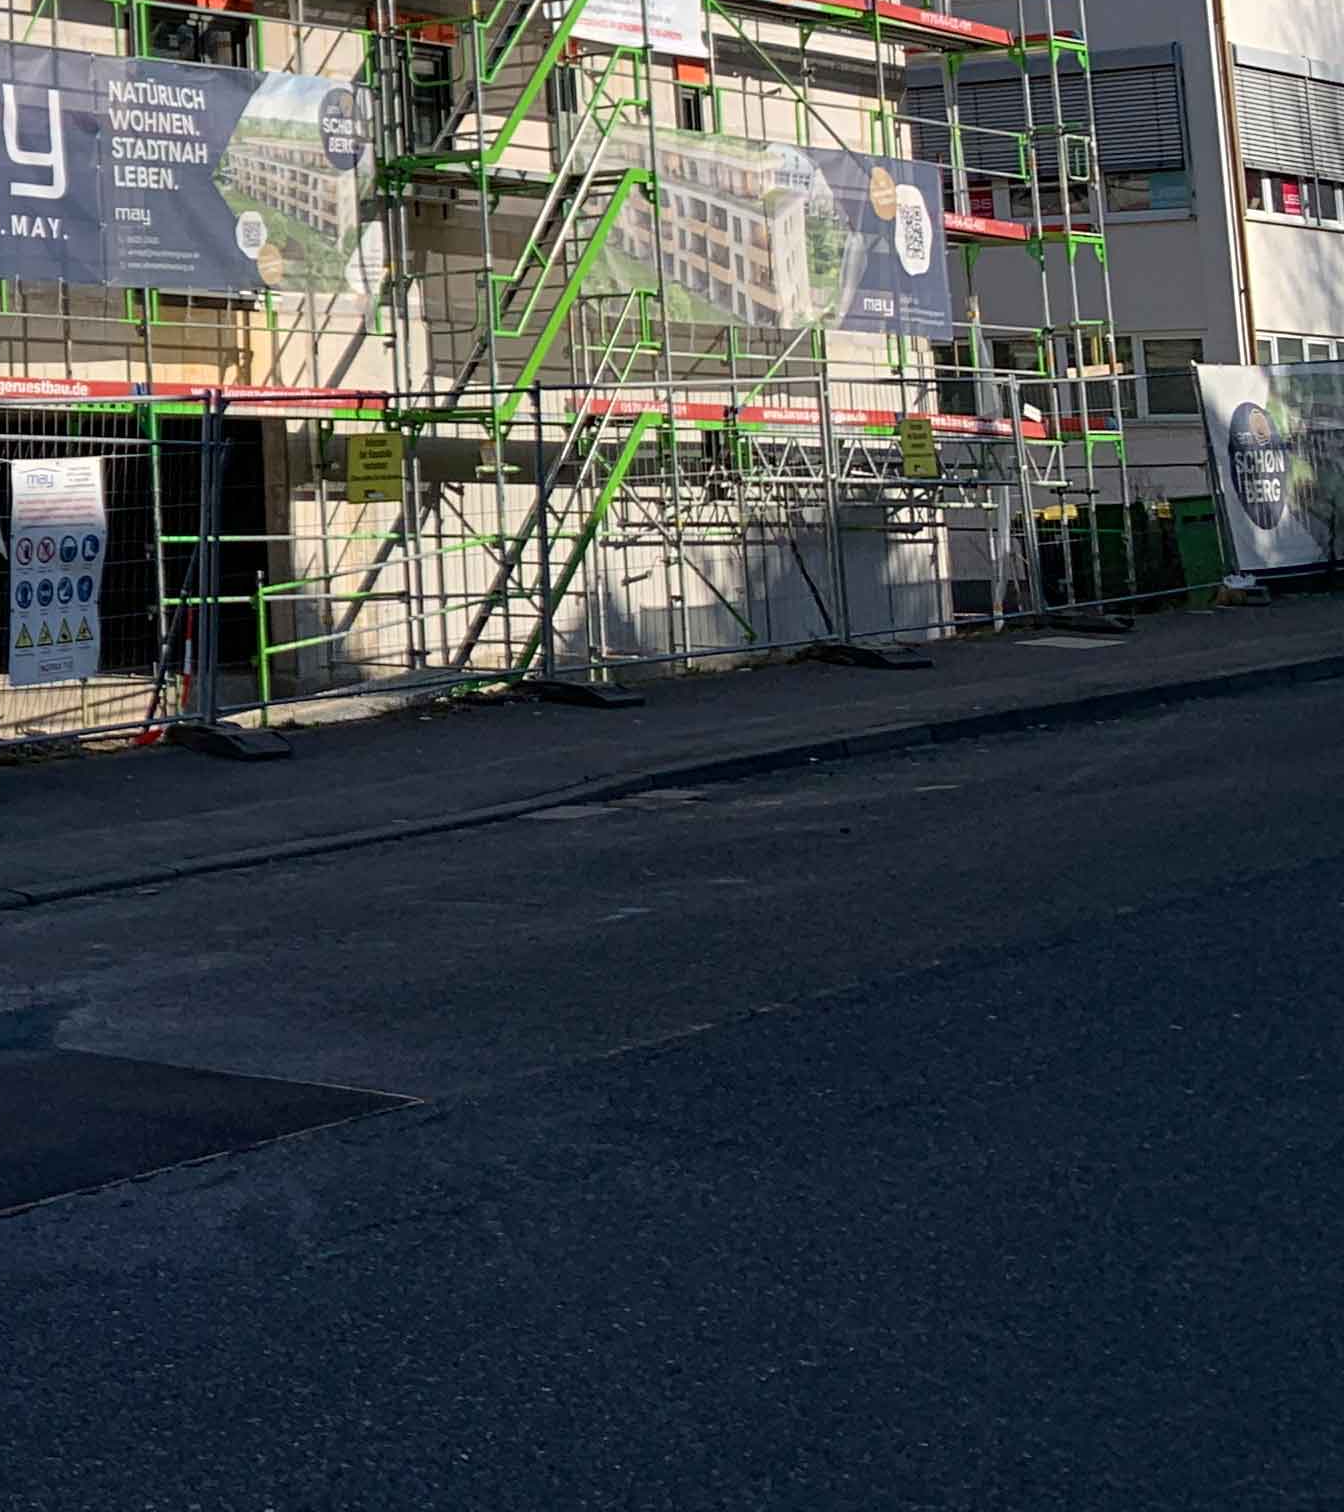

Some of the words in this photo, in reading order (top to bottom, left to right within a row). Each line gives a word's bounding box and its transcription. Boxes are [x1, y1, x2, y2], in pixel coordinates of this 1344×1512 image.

[109, 79, 205, 112] NATÜRLICH
[109, 108, 201, 137] WOHNEN.
[111, 138, 208, 165] STADTNAH
[114, 165, 180, 191] LEBEN.
[11, 214, 69, 240] MAY.
[115, 207, 151, 226] may
[863, 296, 894, 317] may
[1234, 449, 1284, 473] SCHØN
[26, 473, 54, 489] may
[1246, 479, 1281, 503] BERG
